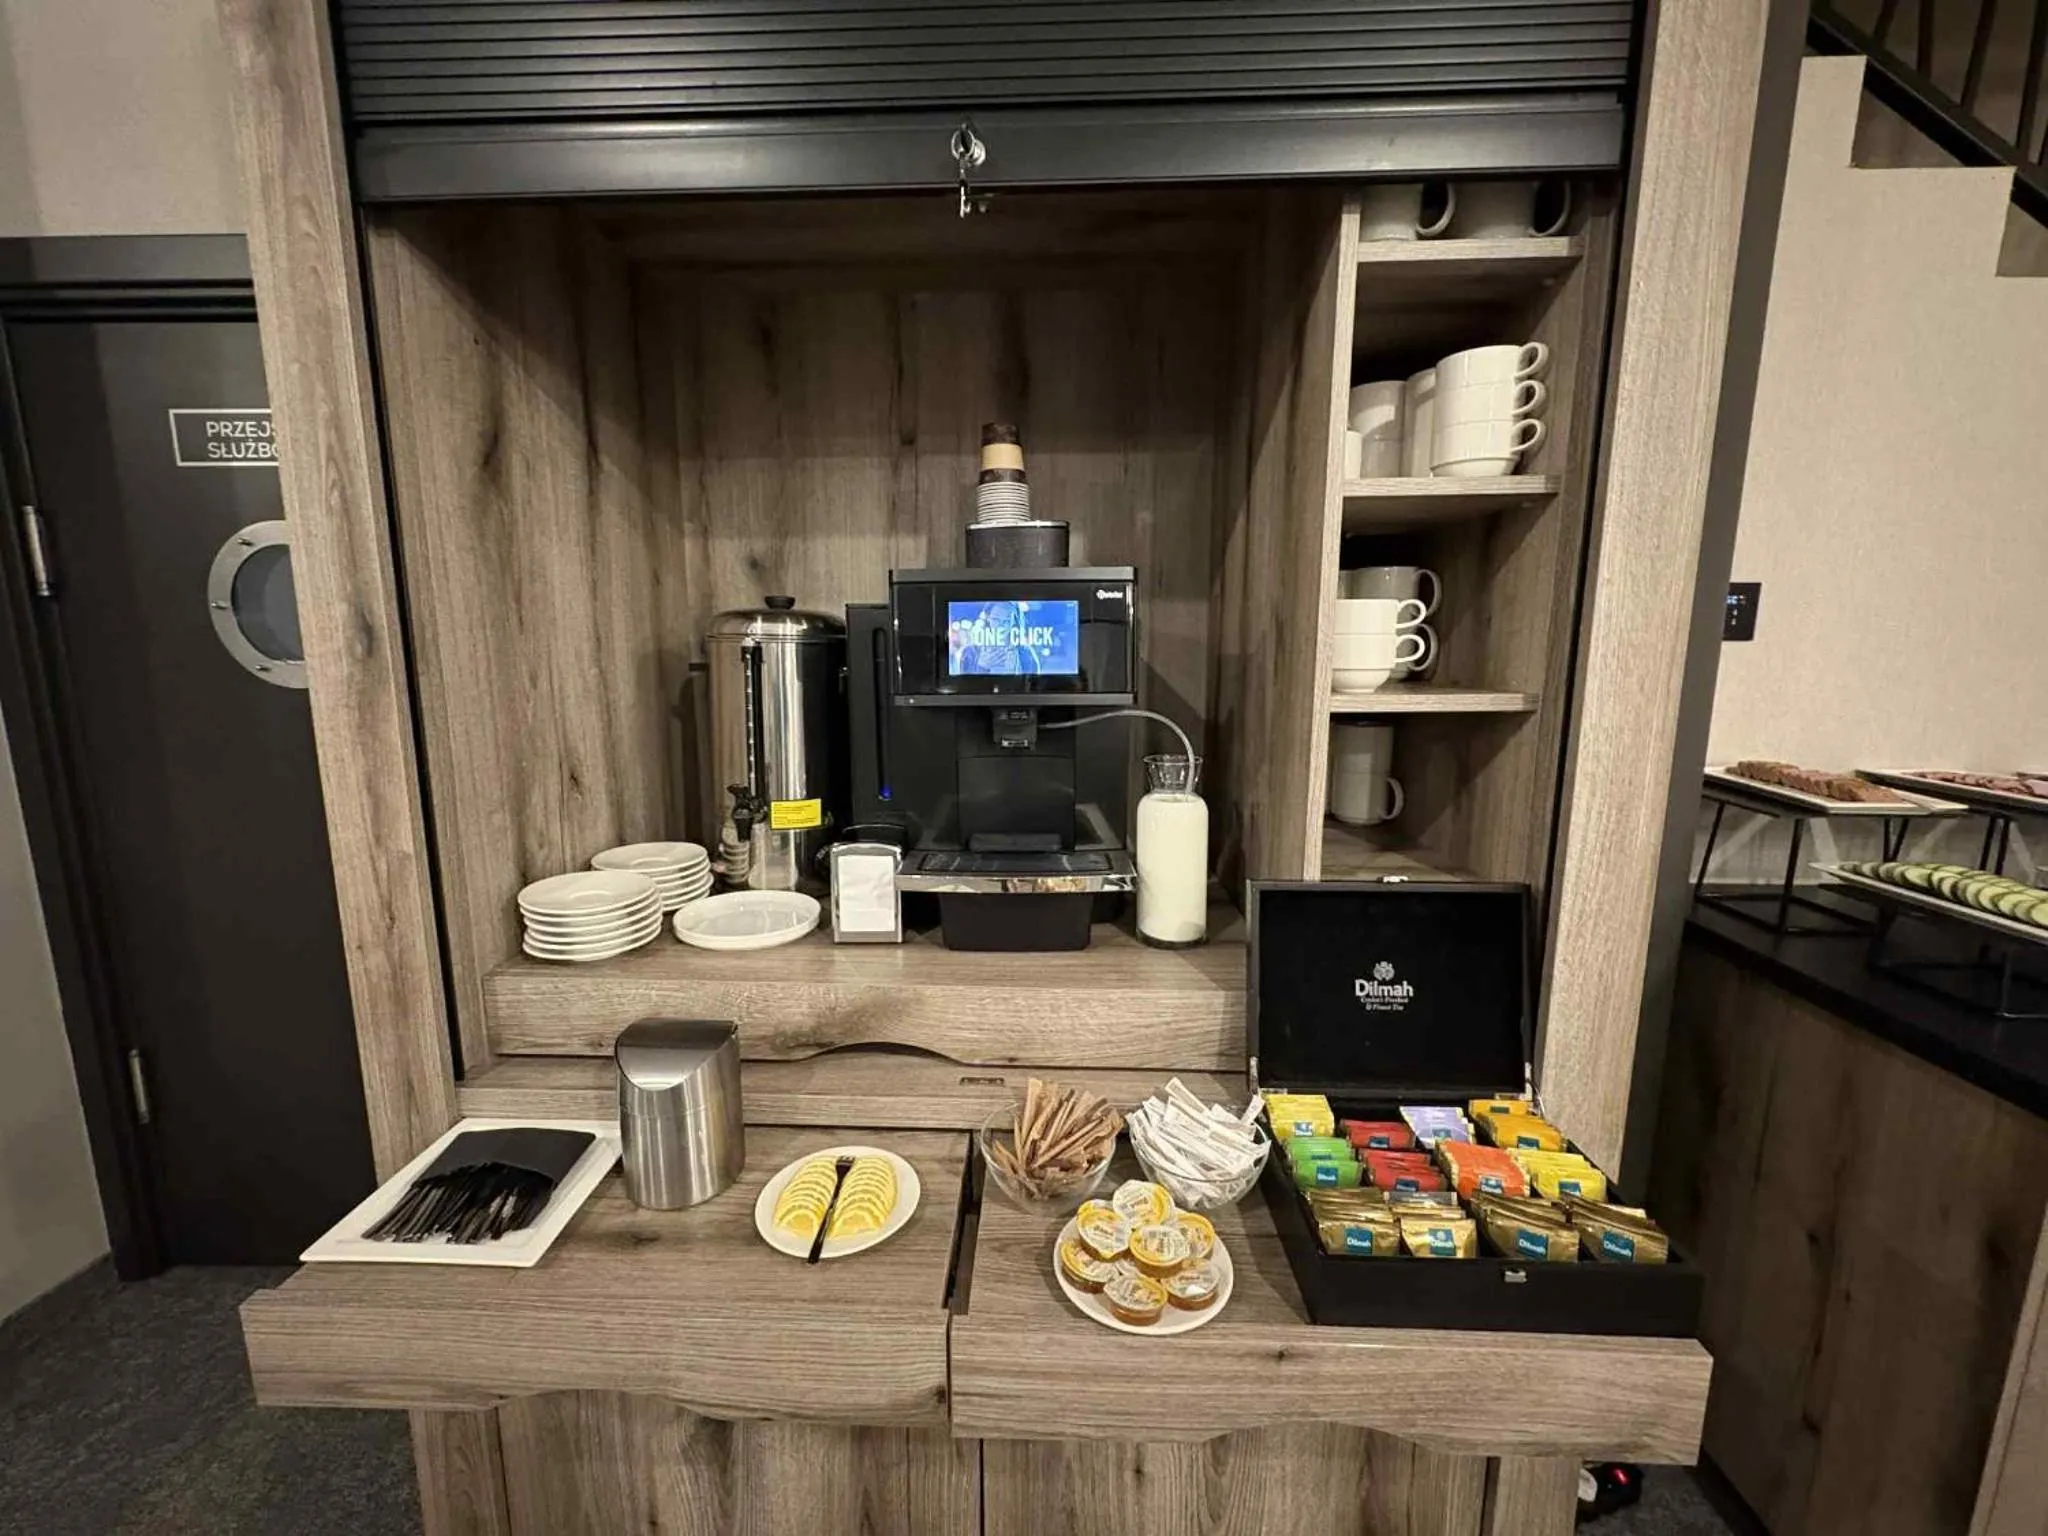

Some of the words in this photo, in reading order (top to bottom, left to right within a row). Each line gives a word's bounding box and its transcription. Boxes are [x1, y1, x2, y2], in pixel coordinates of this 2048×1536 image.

[205, 421, 271, 437] PRZEJ
[974, 626, 1006, 646] ONE
[1010, 626, 1054, 647] CLICK
[1355, 979, 1414, 997] Dilmah
